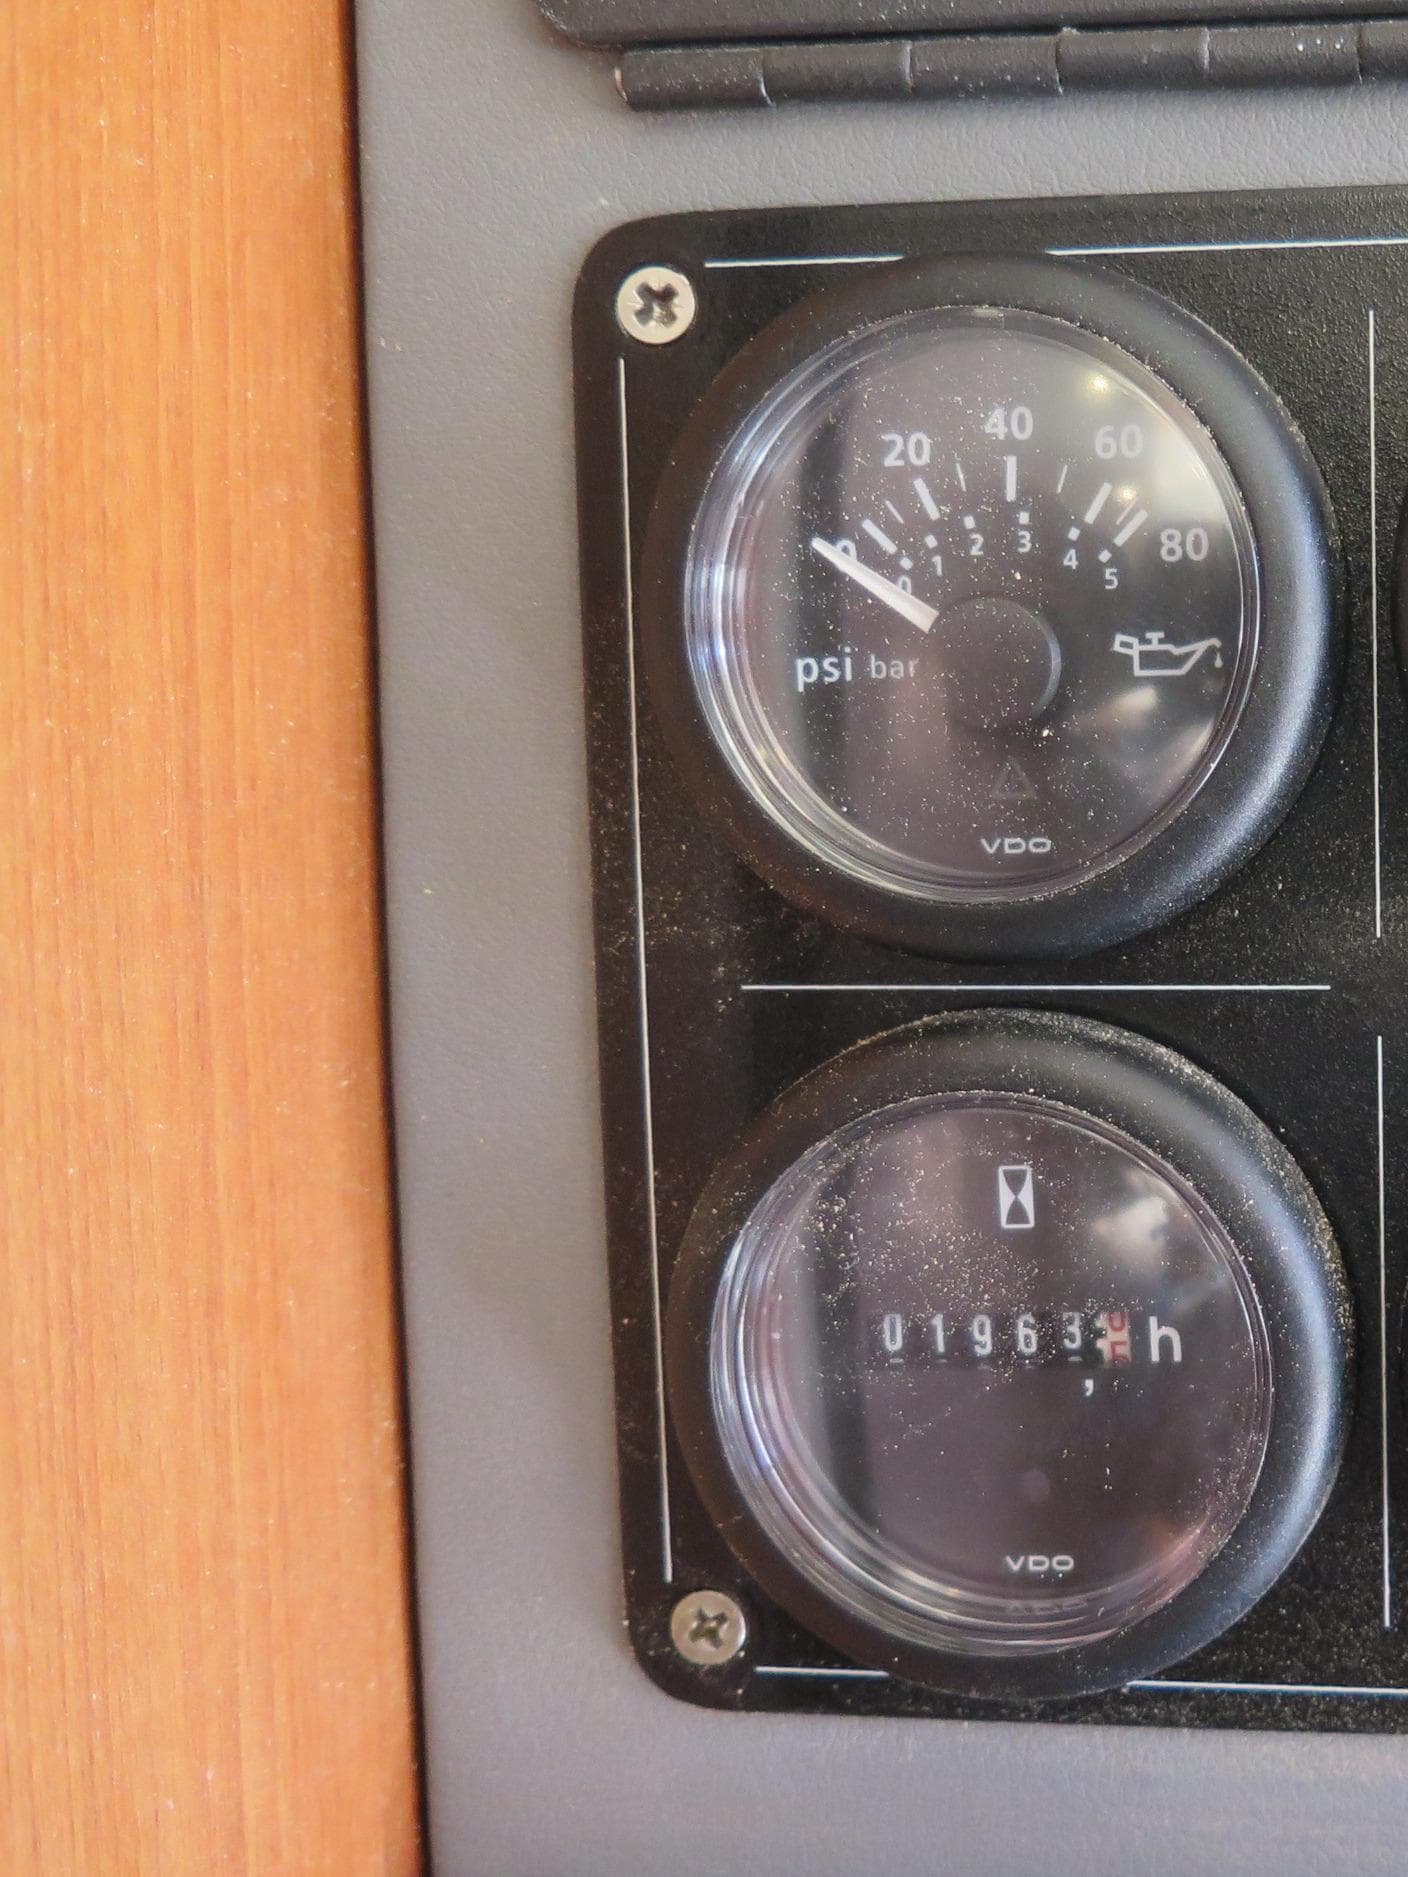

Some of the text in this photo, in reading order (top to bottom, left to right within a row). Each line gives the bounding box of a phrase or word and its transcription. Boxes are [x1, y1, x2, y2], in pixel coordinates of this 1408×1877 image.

[984, 406, 1034, 441] 40
[883, 432, 931, 468] 20
[1094, 424, 1144, 460] 60
[969, 533, 985, 556] 2
[1017, 531, 1032, 553] 3
[1160, 528, 1209, 563] 80
[931, 555, 943, 577] 1
[1063, 547, 1078, 571] 4
[1103, 568, 1119, 590] 5
[796, 646, 919, 691] psi bar
[980, 836, 1053, 855] VDO
[1148, 1315, 1183, 1363] h
[1005, 1554, 1075, 1573] VDO
